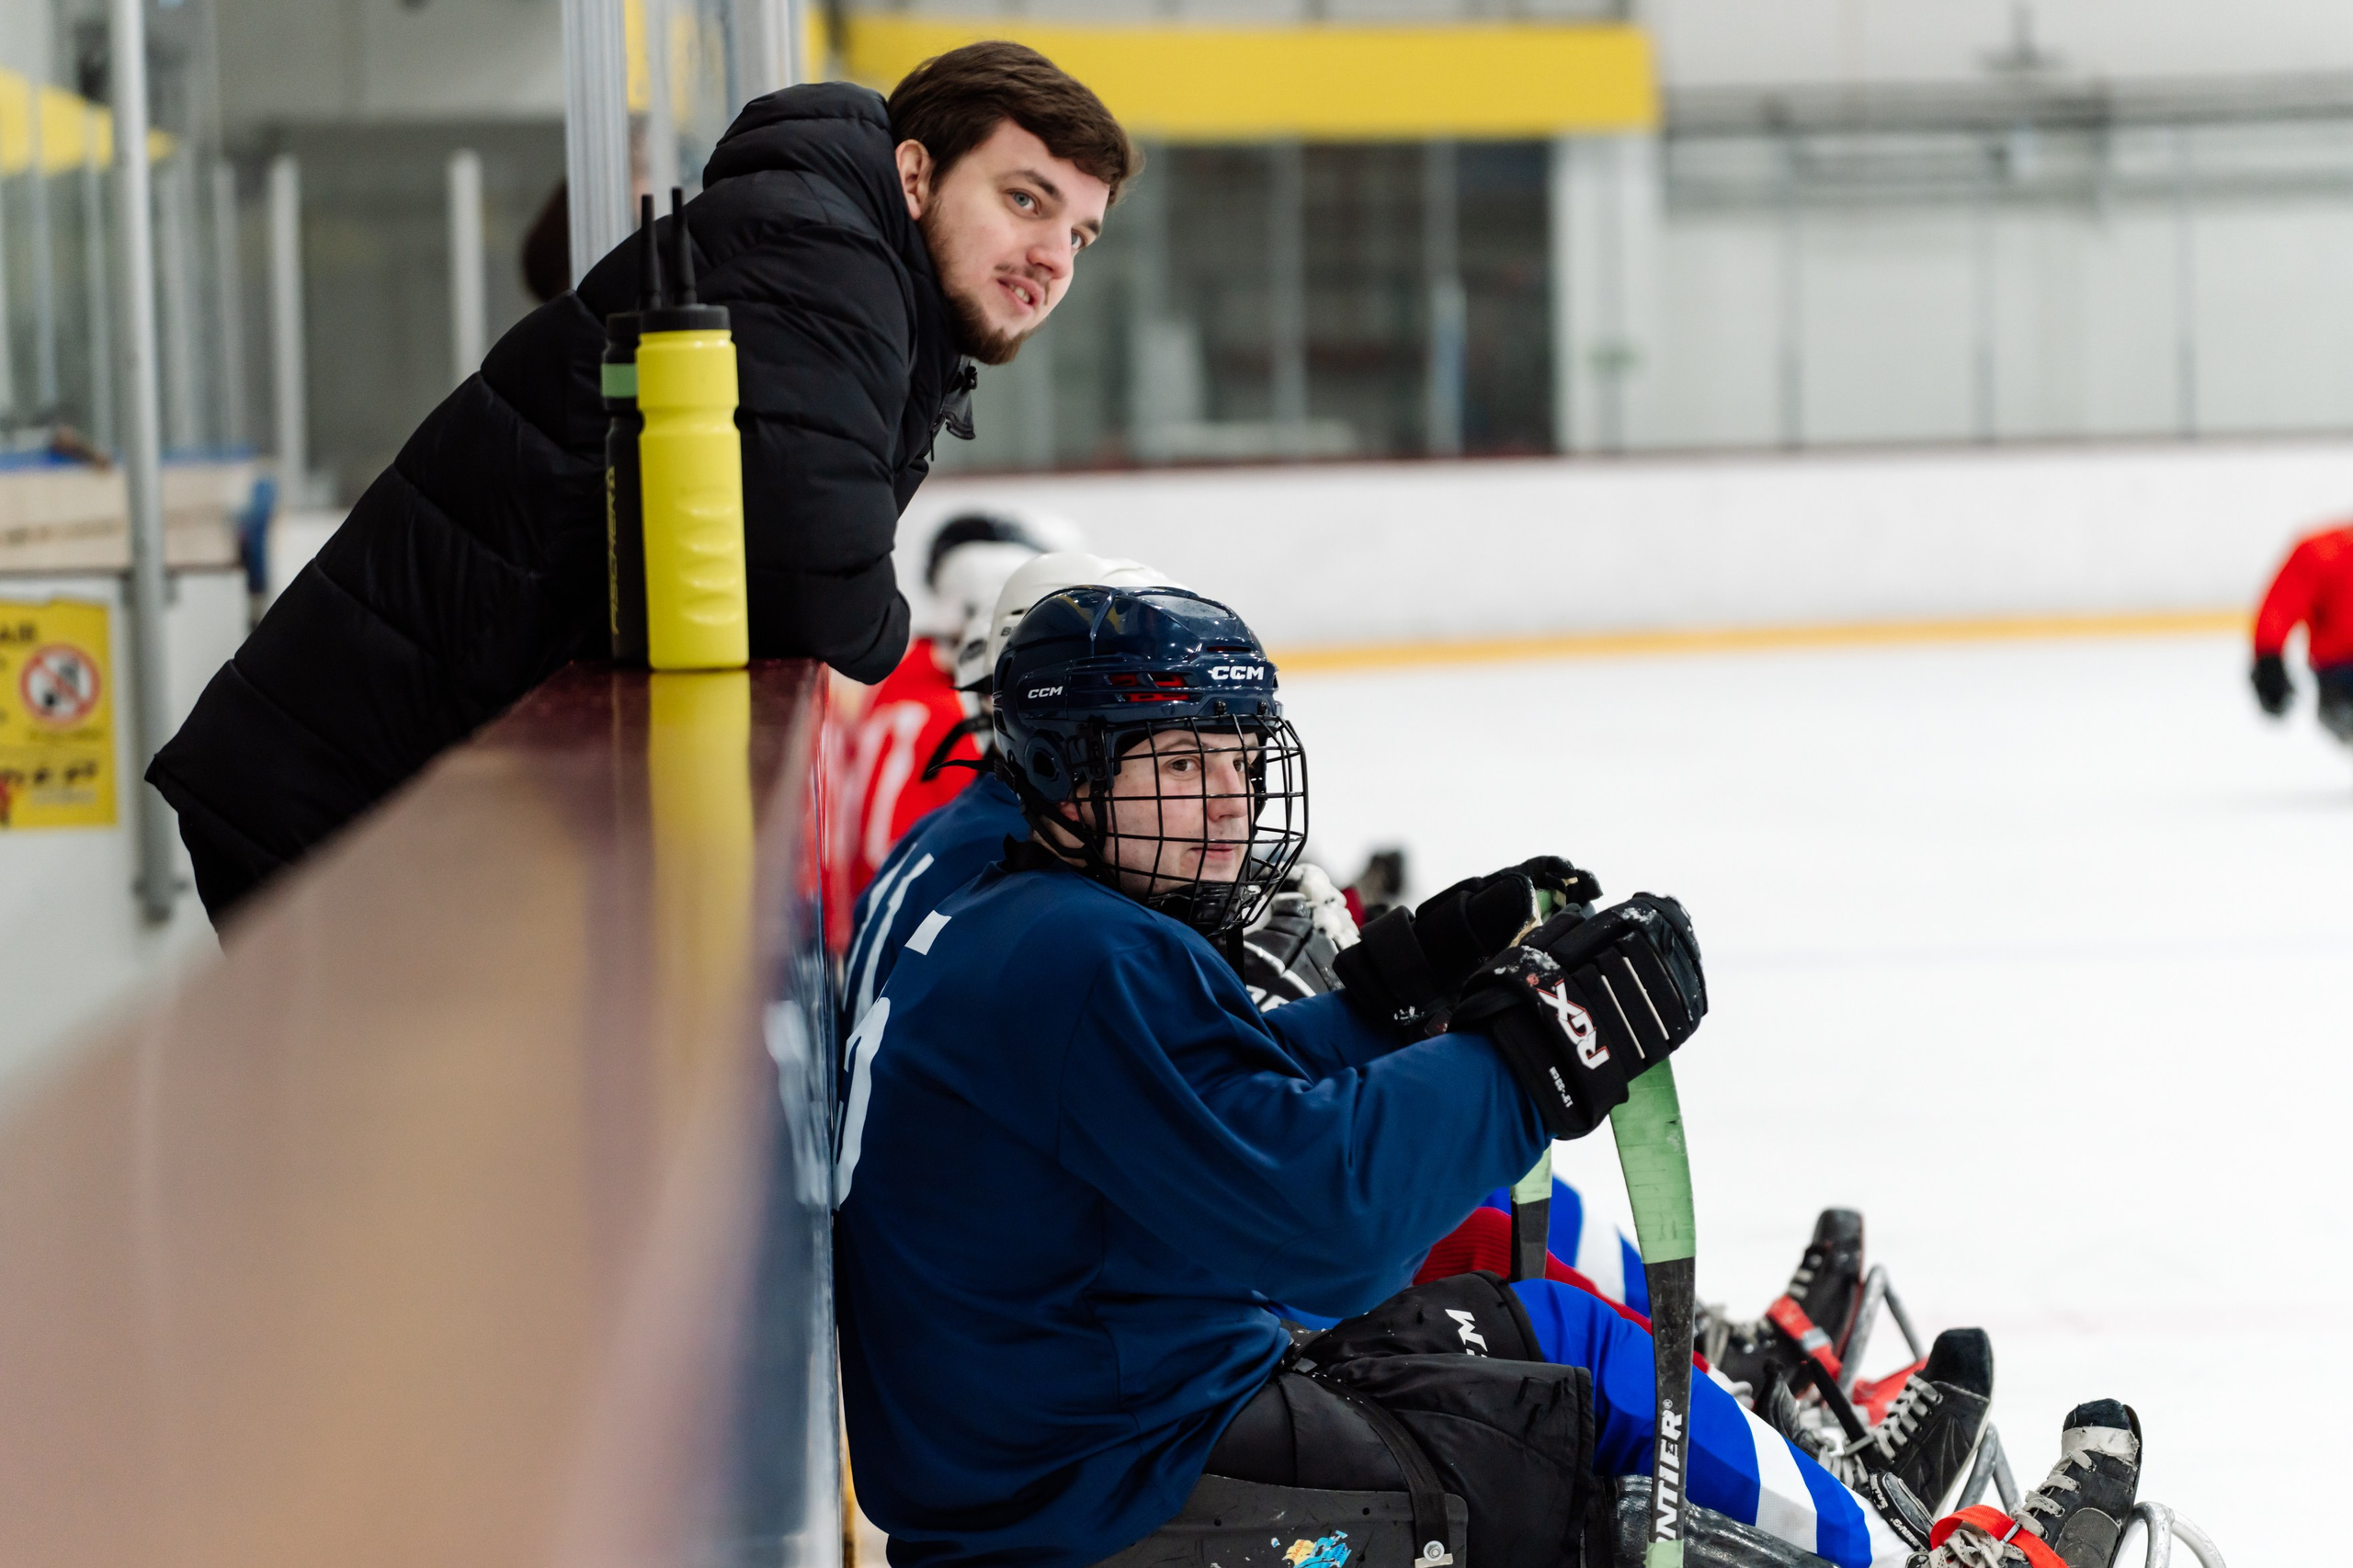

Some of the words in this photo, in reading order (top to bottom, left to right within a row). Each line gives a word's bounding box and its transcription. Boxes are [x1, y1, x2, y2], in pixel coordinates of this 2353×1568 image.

[1211, 665, 1265, 681] CCM
[1027, 685, 1063, 699] CCM
[1537, 979, 1610, 1070] RGX
